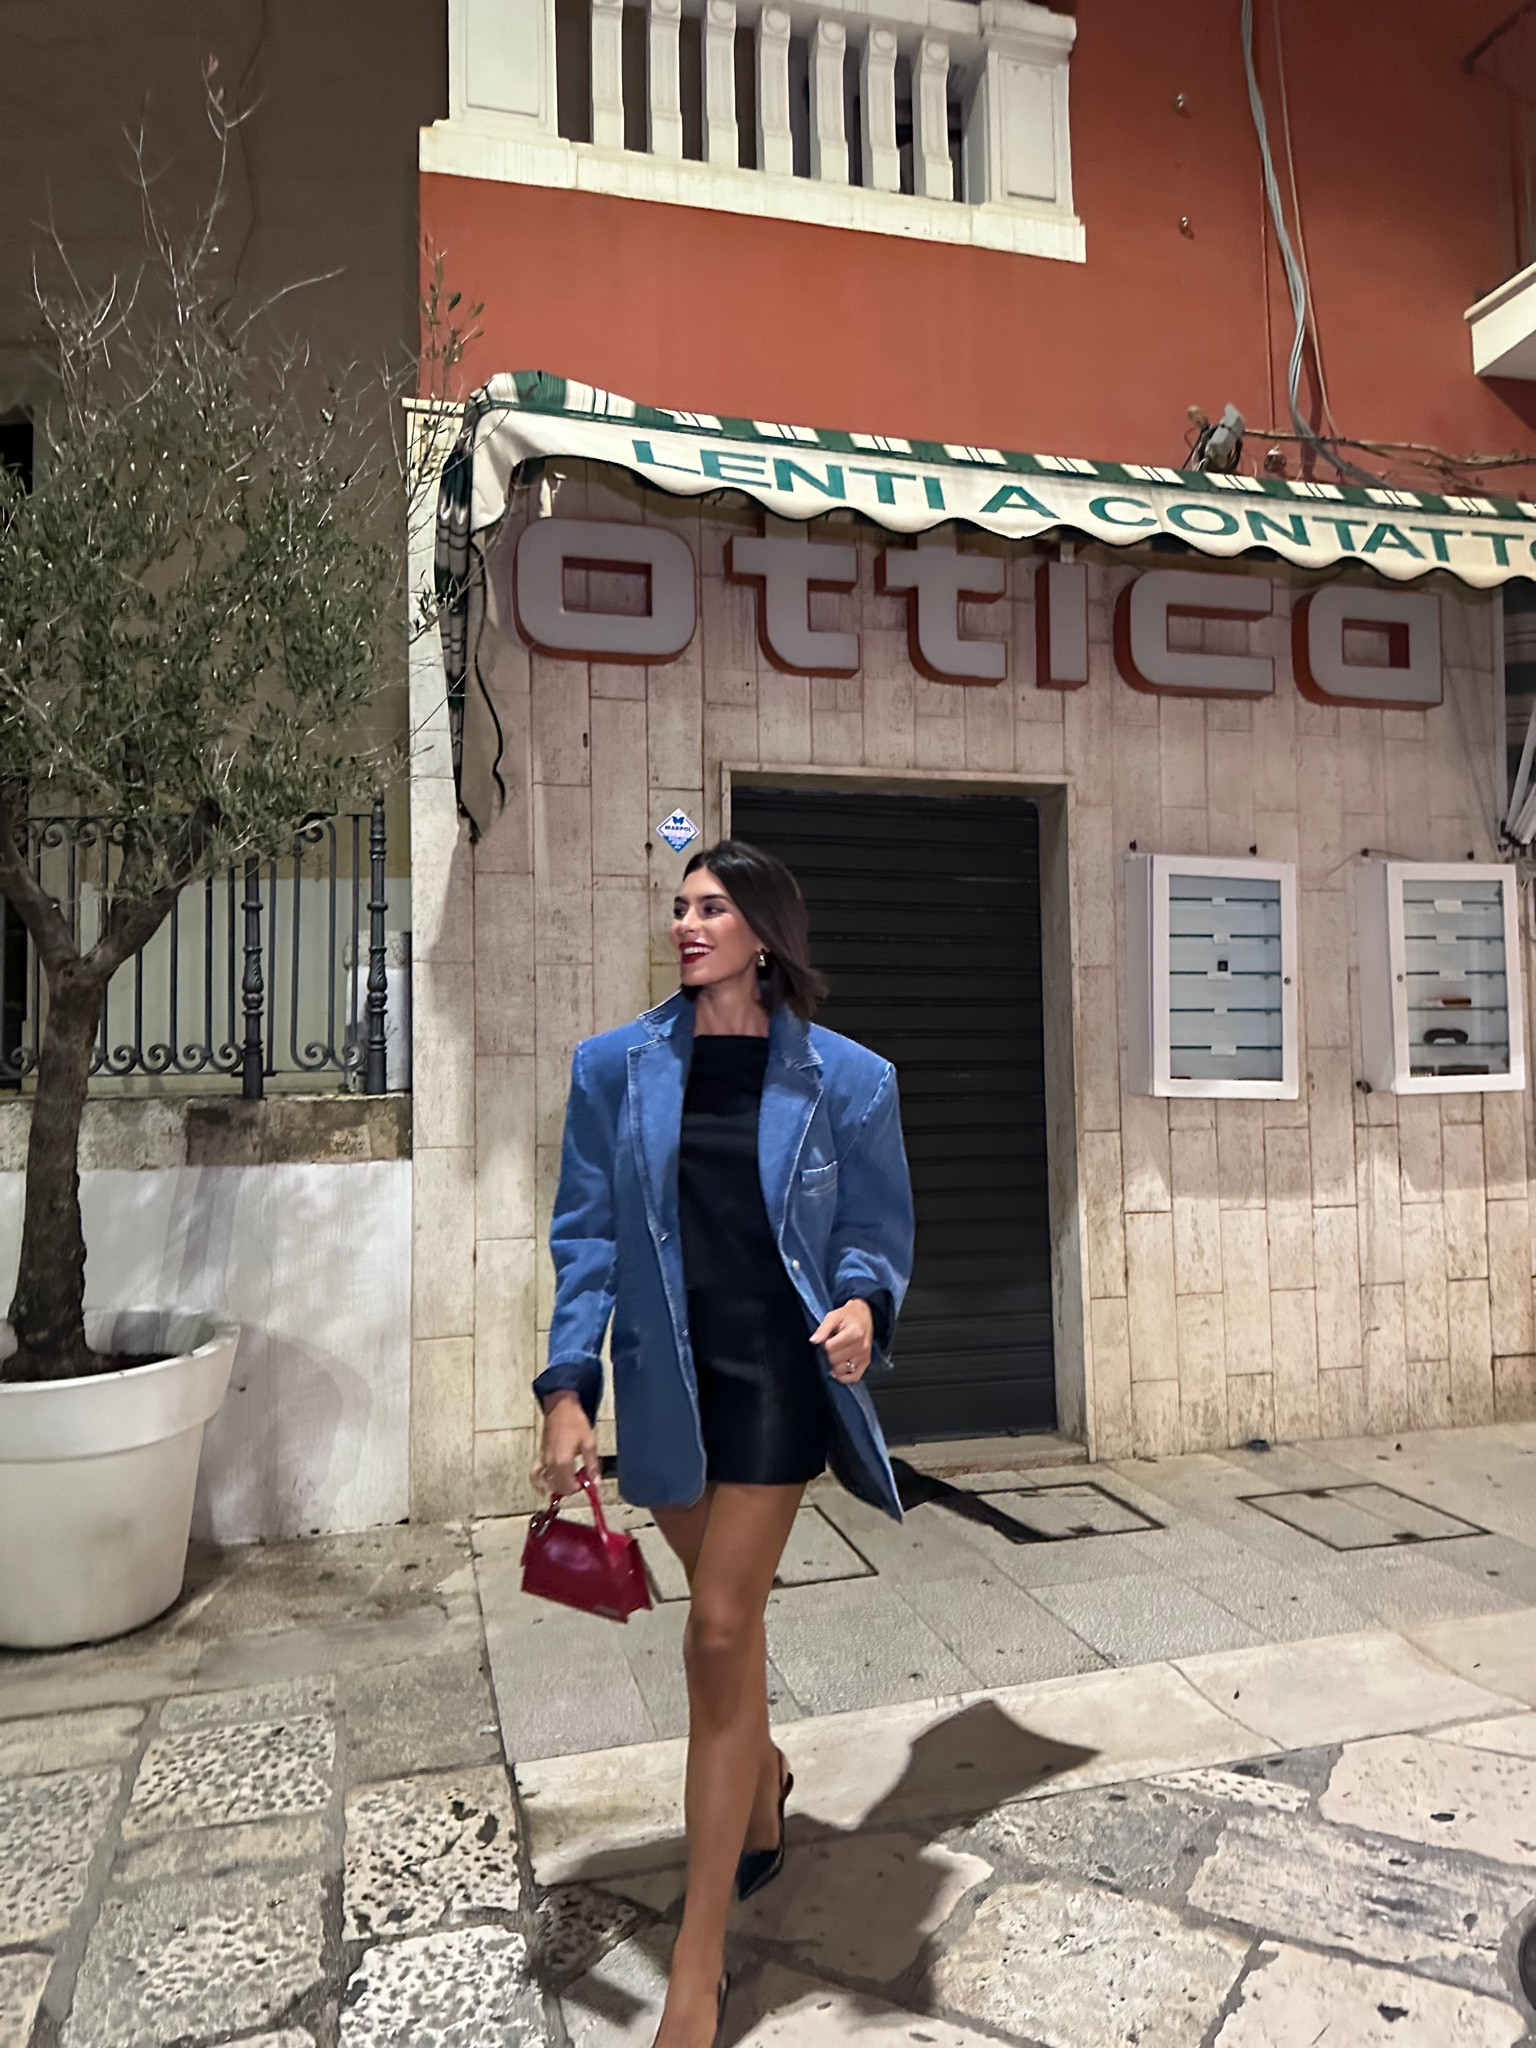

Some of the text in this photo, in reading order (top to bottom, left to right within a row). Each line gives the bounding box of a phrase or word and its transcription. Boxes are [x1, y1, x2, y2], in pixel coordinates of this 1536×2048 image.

[631, 439, 1536, 567] LENTI A CONTATT
